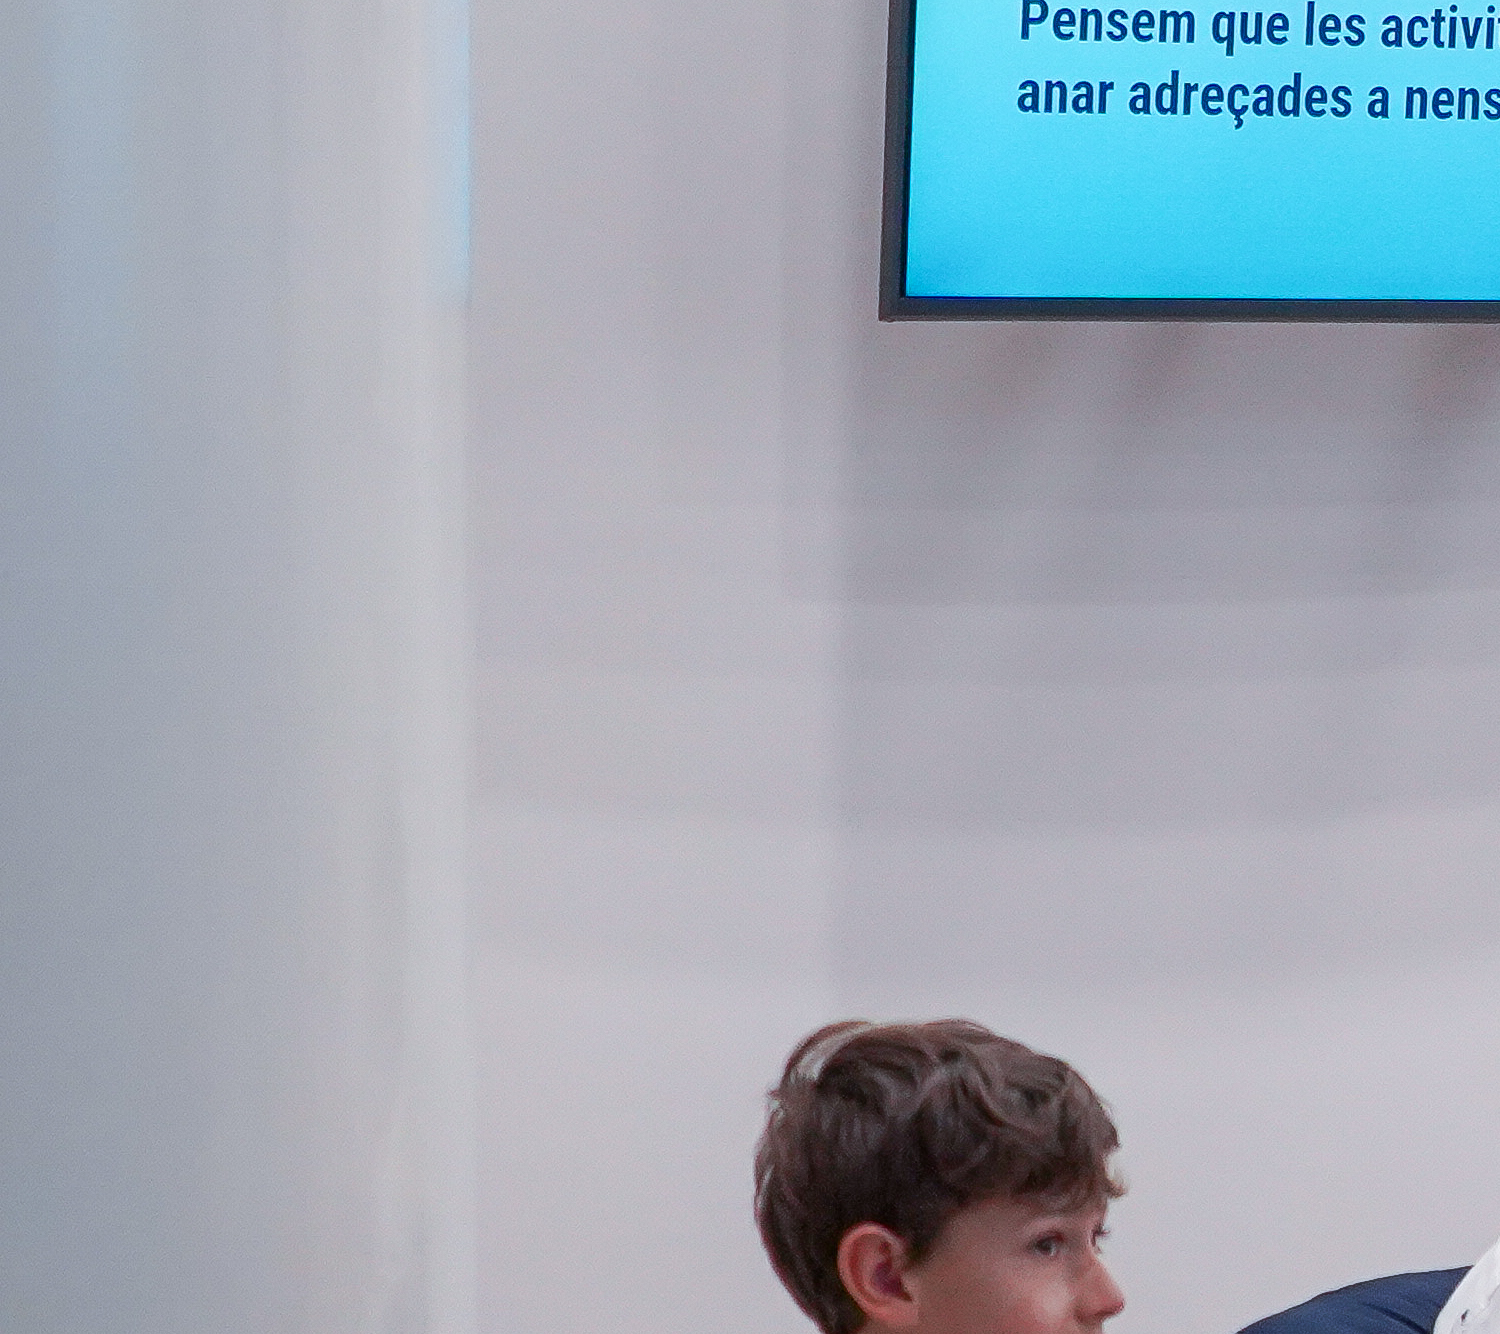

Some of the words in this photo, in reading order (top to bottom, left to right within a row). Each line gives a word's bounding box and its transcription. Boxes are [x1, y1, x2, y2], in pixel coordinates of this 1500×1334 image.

[1211, 11, 1290, 57] que
[1305, 0, 1367, 47] les
[1017, 79, 1115, 115] anar
[1128, 69, 1353, 130] adreçades
[1367, 86, 1390, 119] a
